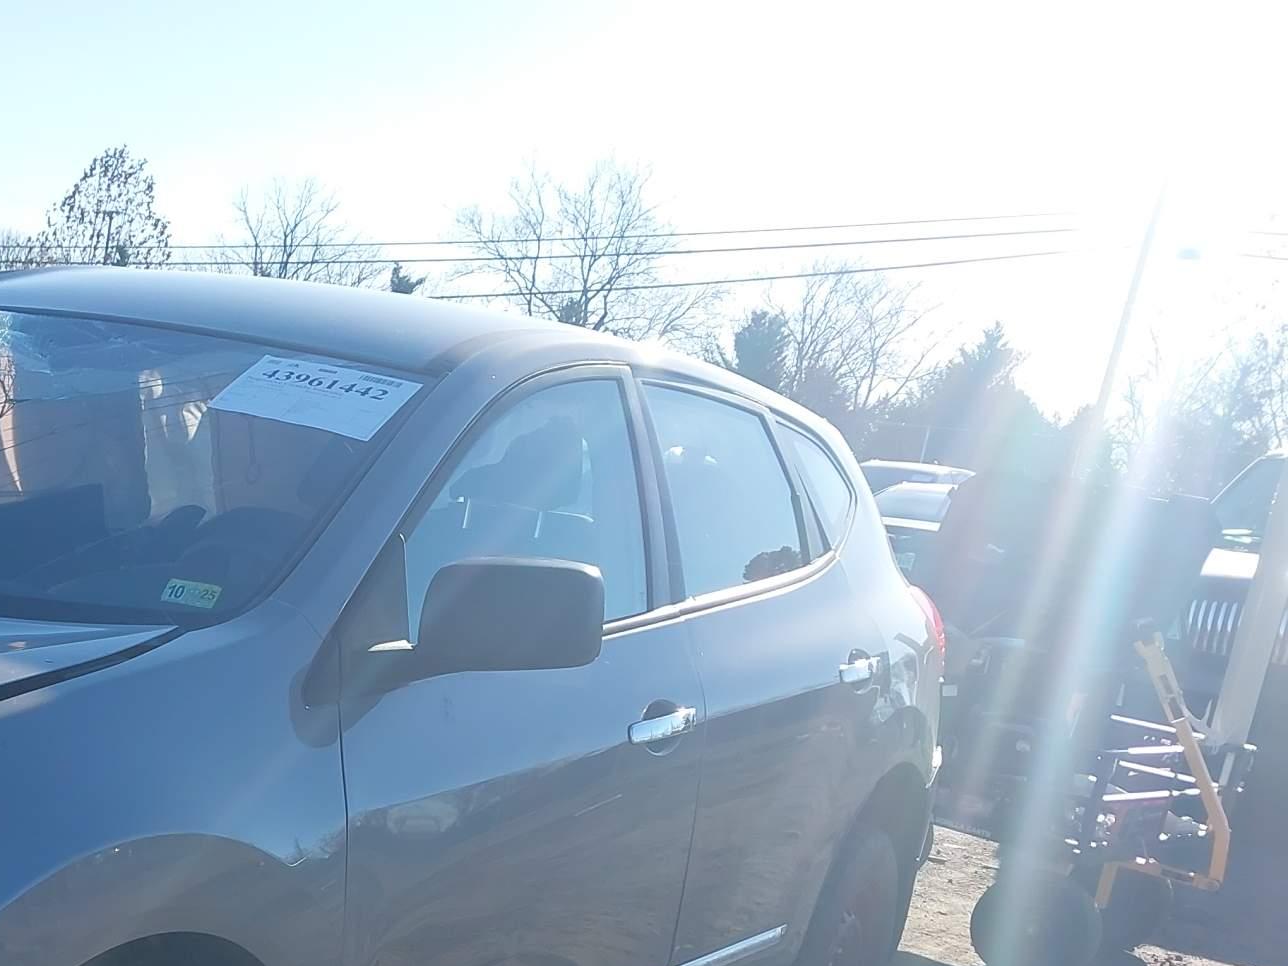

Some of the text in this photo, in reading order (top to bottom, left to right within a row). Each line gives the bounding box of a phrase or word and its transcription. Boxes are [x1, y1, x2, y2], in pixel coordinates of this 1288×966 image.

[262, 369, 389, 400] 43961442
[168, 584, 217, 601] 10 25
